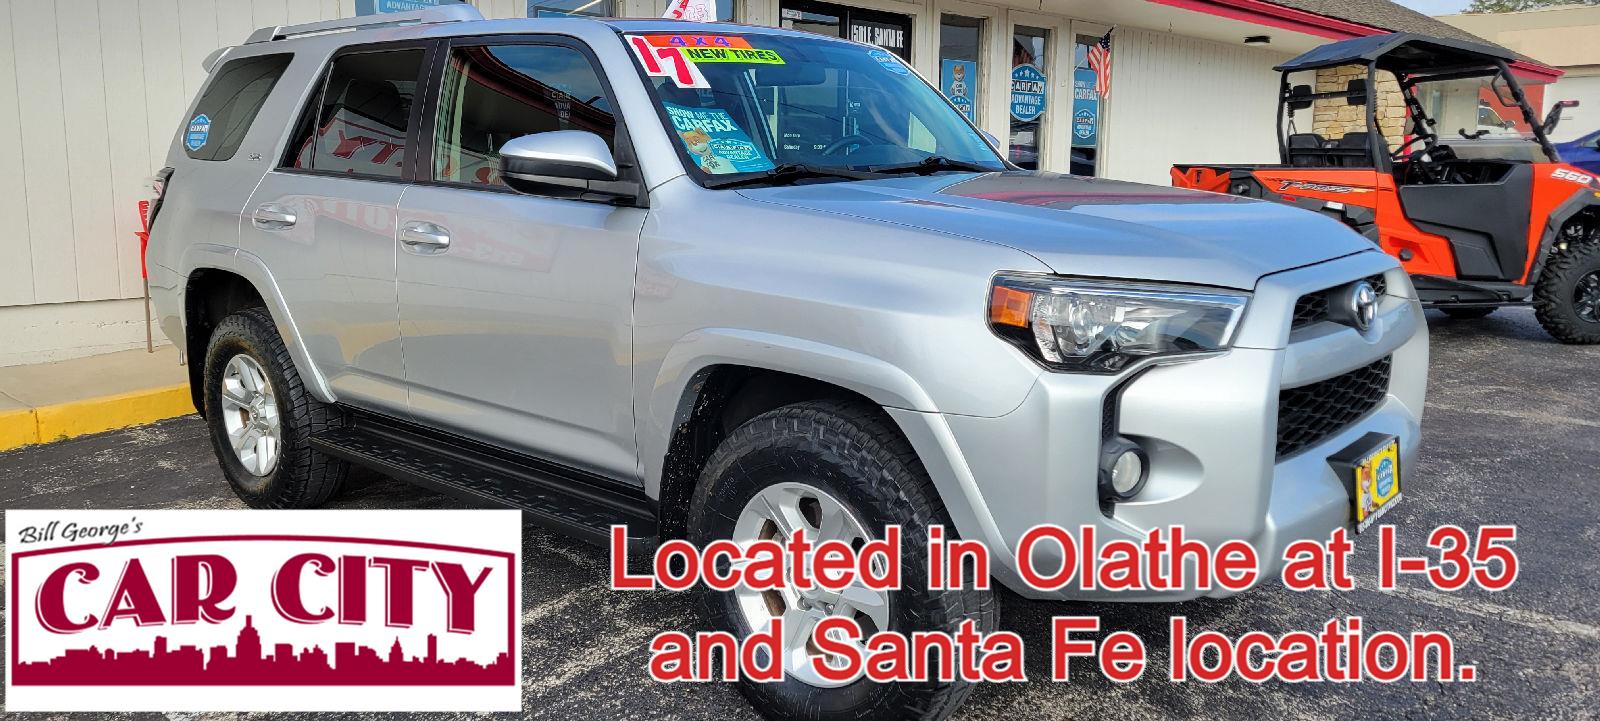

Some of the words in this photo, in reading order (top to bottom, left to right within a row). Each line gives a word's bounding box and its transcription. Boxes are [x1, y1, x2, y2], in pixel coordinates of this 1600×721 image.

[875, 27, 896, 47] SANTA
[896, 30, 904, 48] FE
[631, 36, 694, 85] 17
[686, 48, 726, 59] NEW
[728, 49, 778, 61] TIRES
[1011, 79, 1044, 94] CARFAX
[1011, 94, 1041, 105] ADVANTAGE
[666, 106, 694, 119] SHOW
[1015, 105, 1036, 115] DEALER
[671, 115, 738, 133] CARFAX
